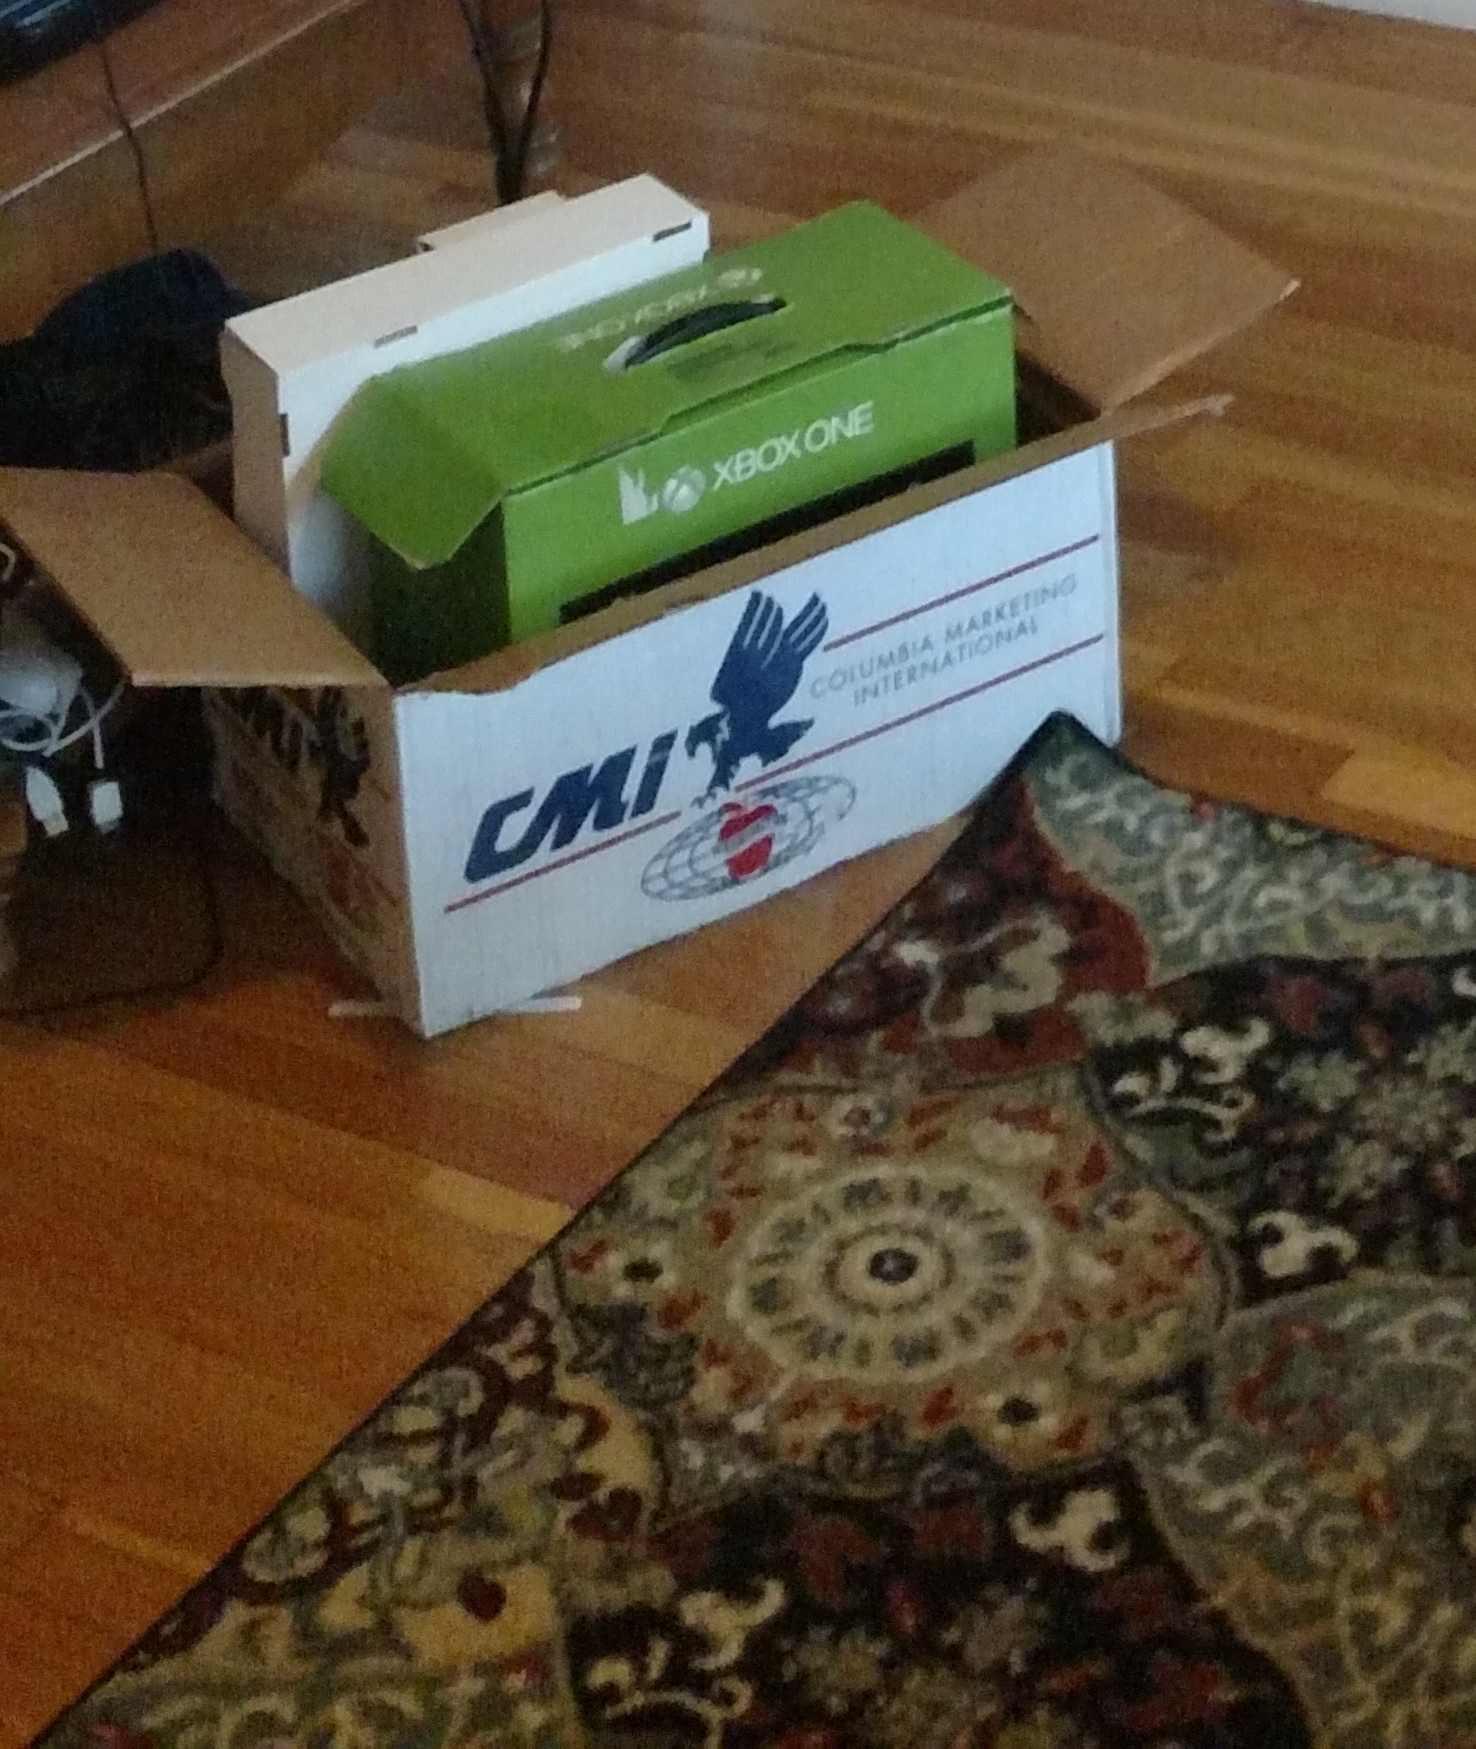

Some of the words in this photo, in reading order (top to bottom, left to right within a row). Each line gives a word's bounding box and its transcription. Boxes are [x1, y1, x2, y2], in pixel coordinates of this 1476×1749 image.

[712, 427, 802, 492] XBOX
[803, 400, 874, 453] ONE
[809, 633, 934, 700] COLUMBIA
[944, 572, 1078, 644] MARKETING
[853, 615, 1039, 708] INTERNATIONAL
[463, 718, 678, 885] CMI
